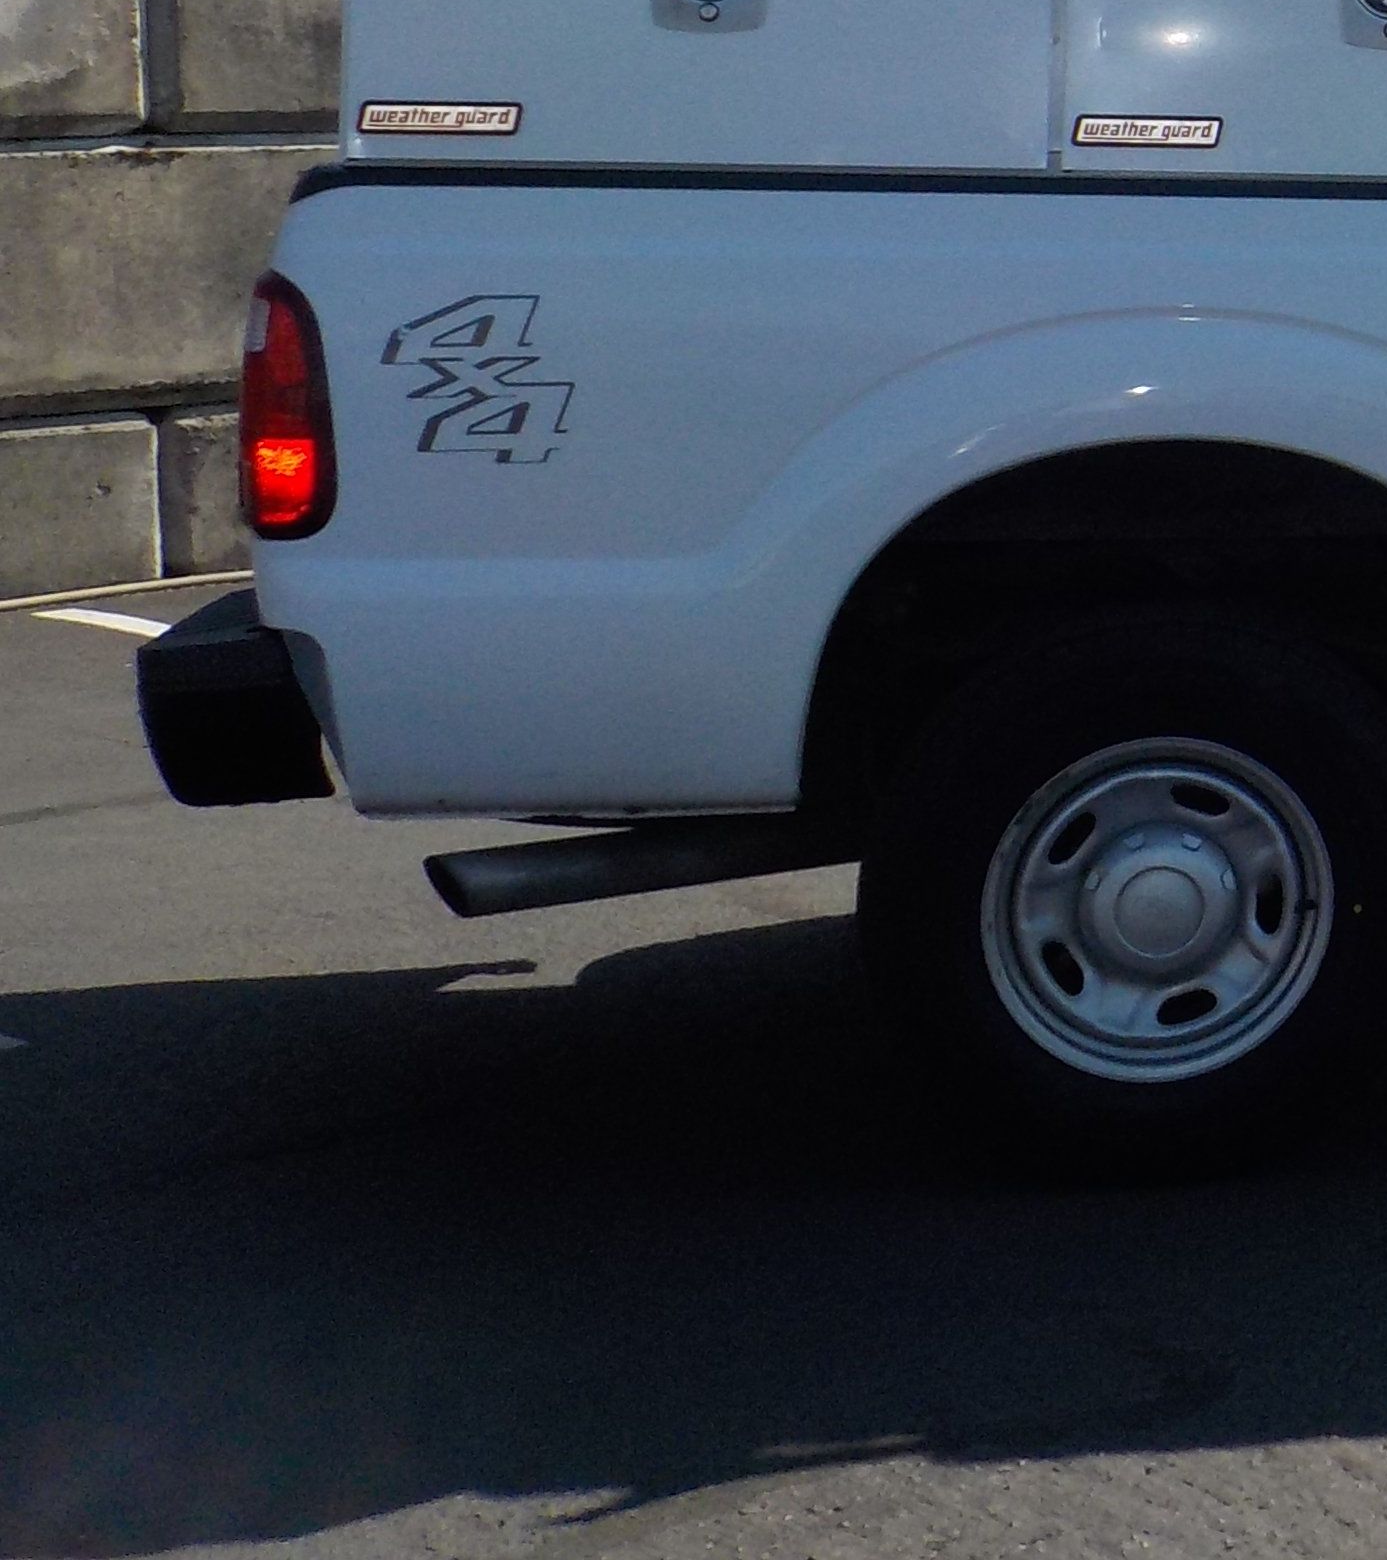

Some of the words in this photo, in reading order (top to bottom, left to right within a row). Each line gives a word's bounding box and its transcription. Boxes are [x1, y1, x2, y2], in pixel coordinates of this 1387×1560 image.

[368, 107, 451, 124] weather
[454, 108, 511, 128] guard
[1083, 121, 1159, 137] weather
[1160, 123, 1212, 141] guard
